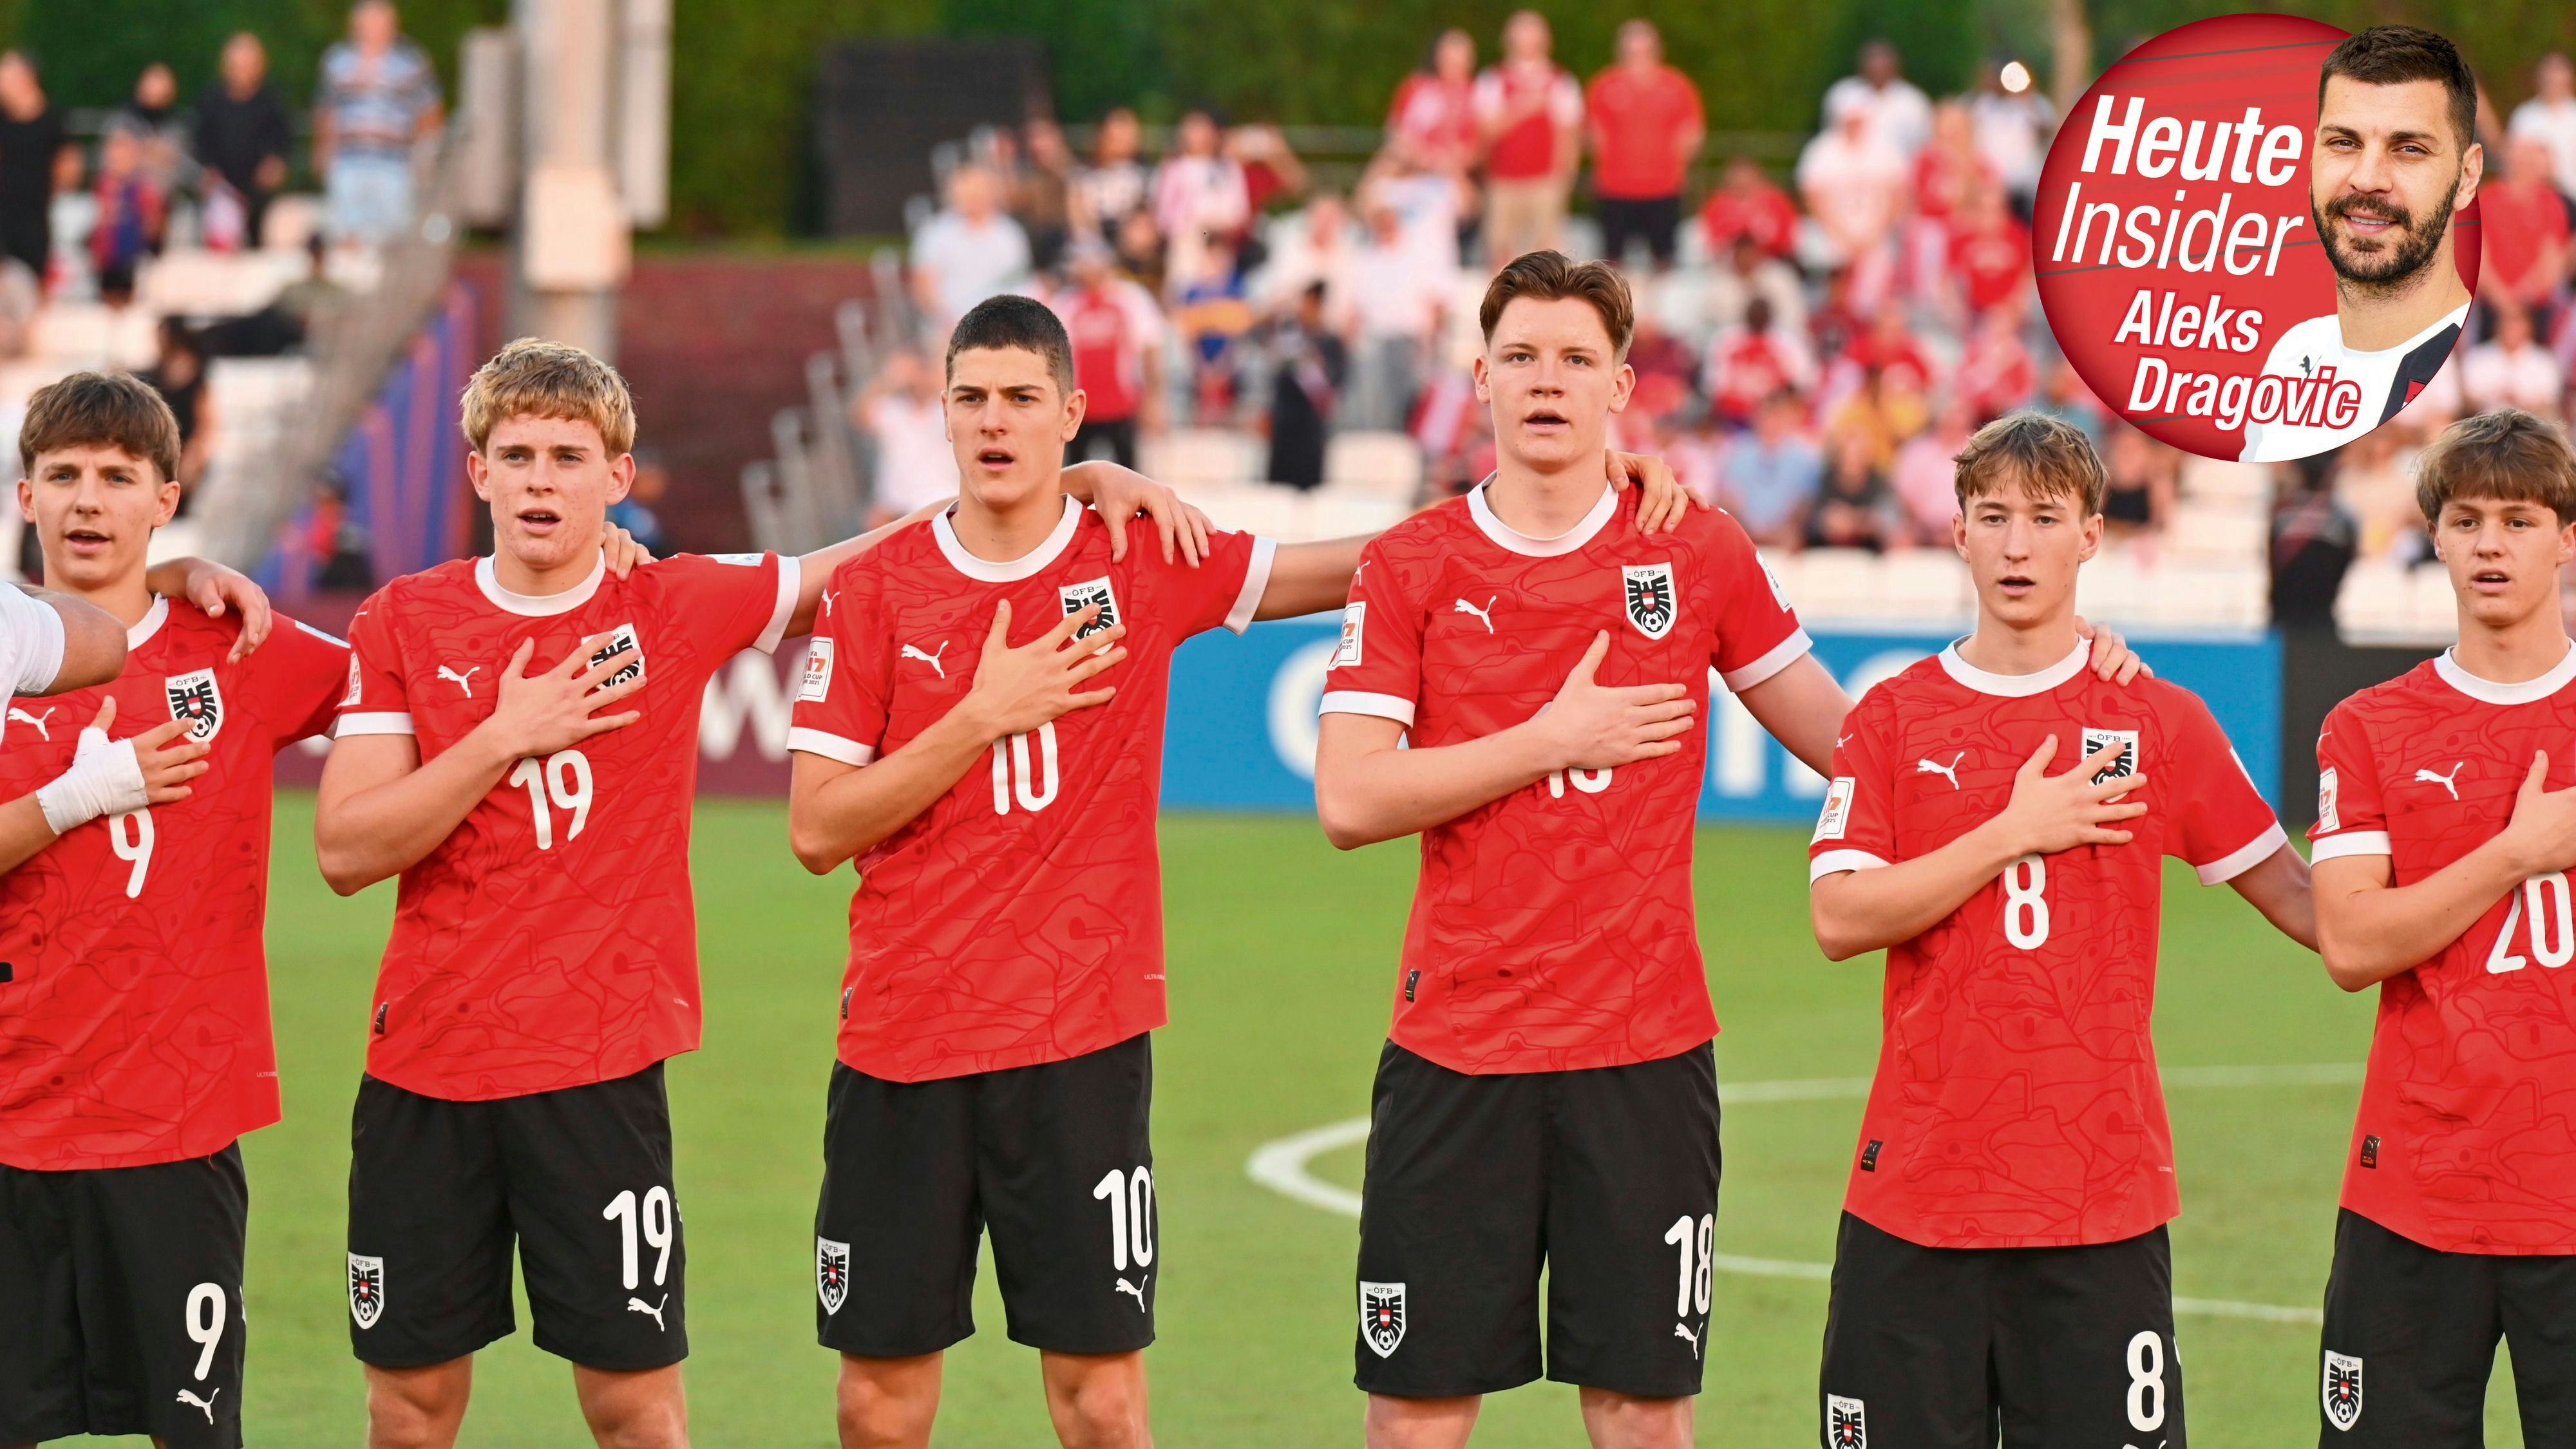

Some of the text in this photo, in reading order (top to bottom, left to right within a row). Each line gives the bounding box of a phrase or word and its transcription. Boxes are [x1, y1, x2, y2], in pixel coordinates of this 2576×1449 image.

[1072, 586, 1095, 596] ÖFB
[176, 676, 199, 687] ÖFB
[807, 657, 826, 672] 17
[992, 721, 1059, 815] 10
[2097, 732, 2121, 742] ÖFB
[509, 750, 593, 850] 19
[108, 807, 155, 898] 9
[2004, 853, 2050, 950] 8
[2486, 871, 2575, 974] 20
[355, 1258, 370, 1267] ÖFB
[603, 1186, 672, 1290] 19
[1093, 1166, 1153, 1271] 10
[1374, 1286, 1393, 1294] ÖFB
[1664, 1213, 1714, 1317] 18
[185, 1282, 227, 1381] 9
[2336, 1357, 2353, 1368] ÖFB
[1839, 1400, 1855, 1410] ÖFB
[2126, 1331, 2165, 1432] 8
